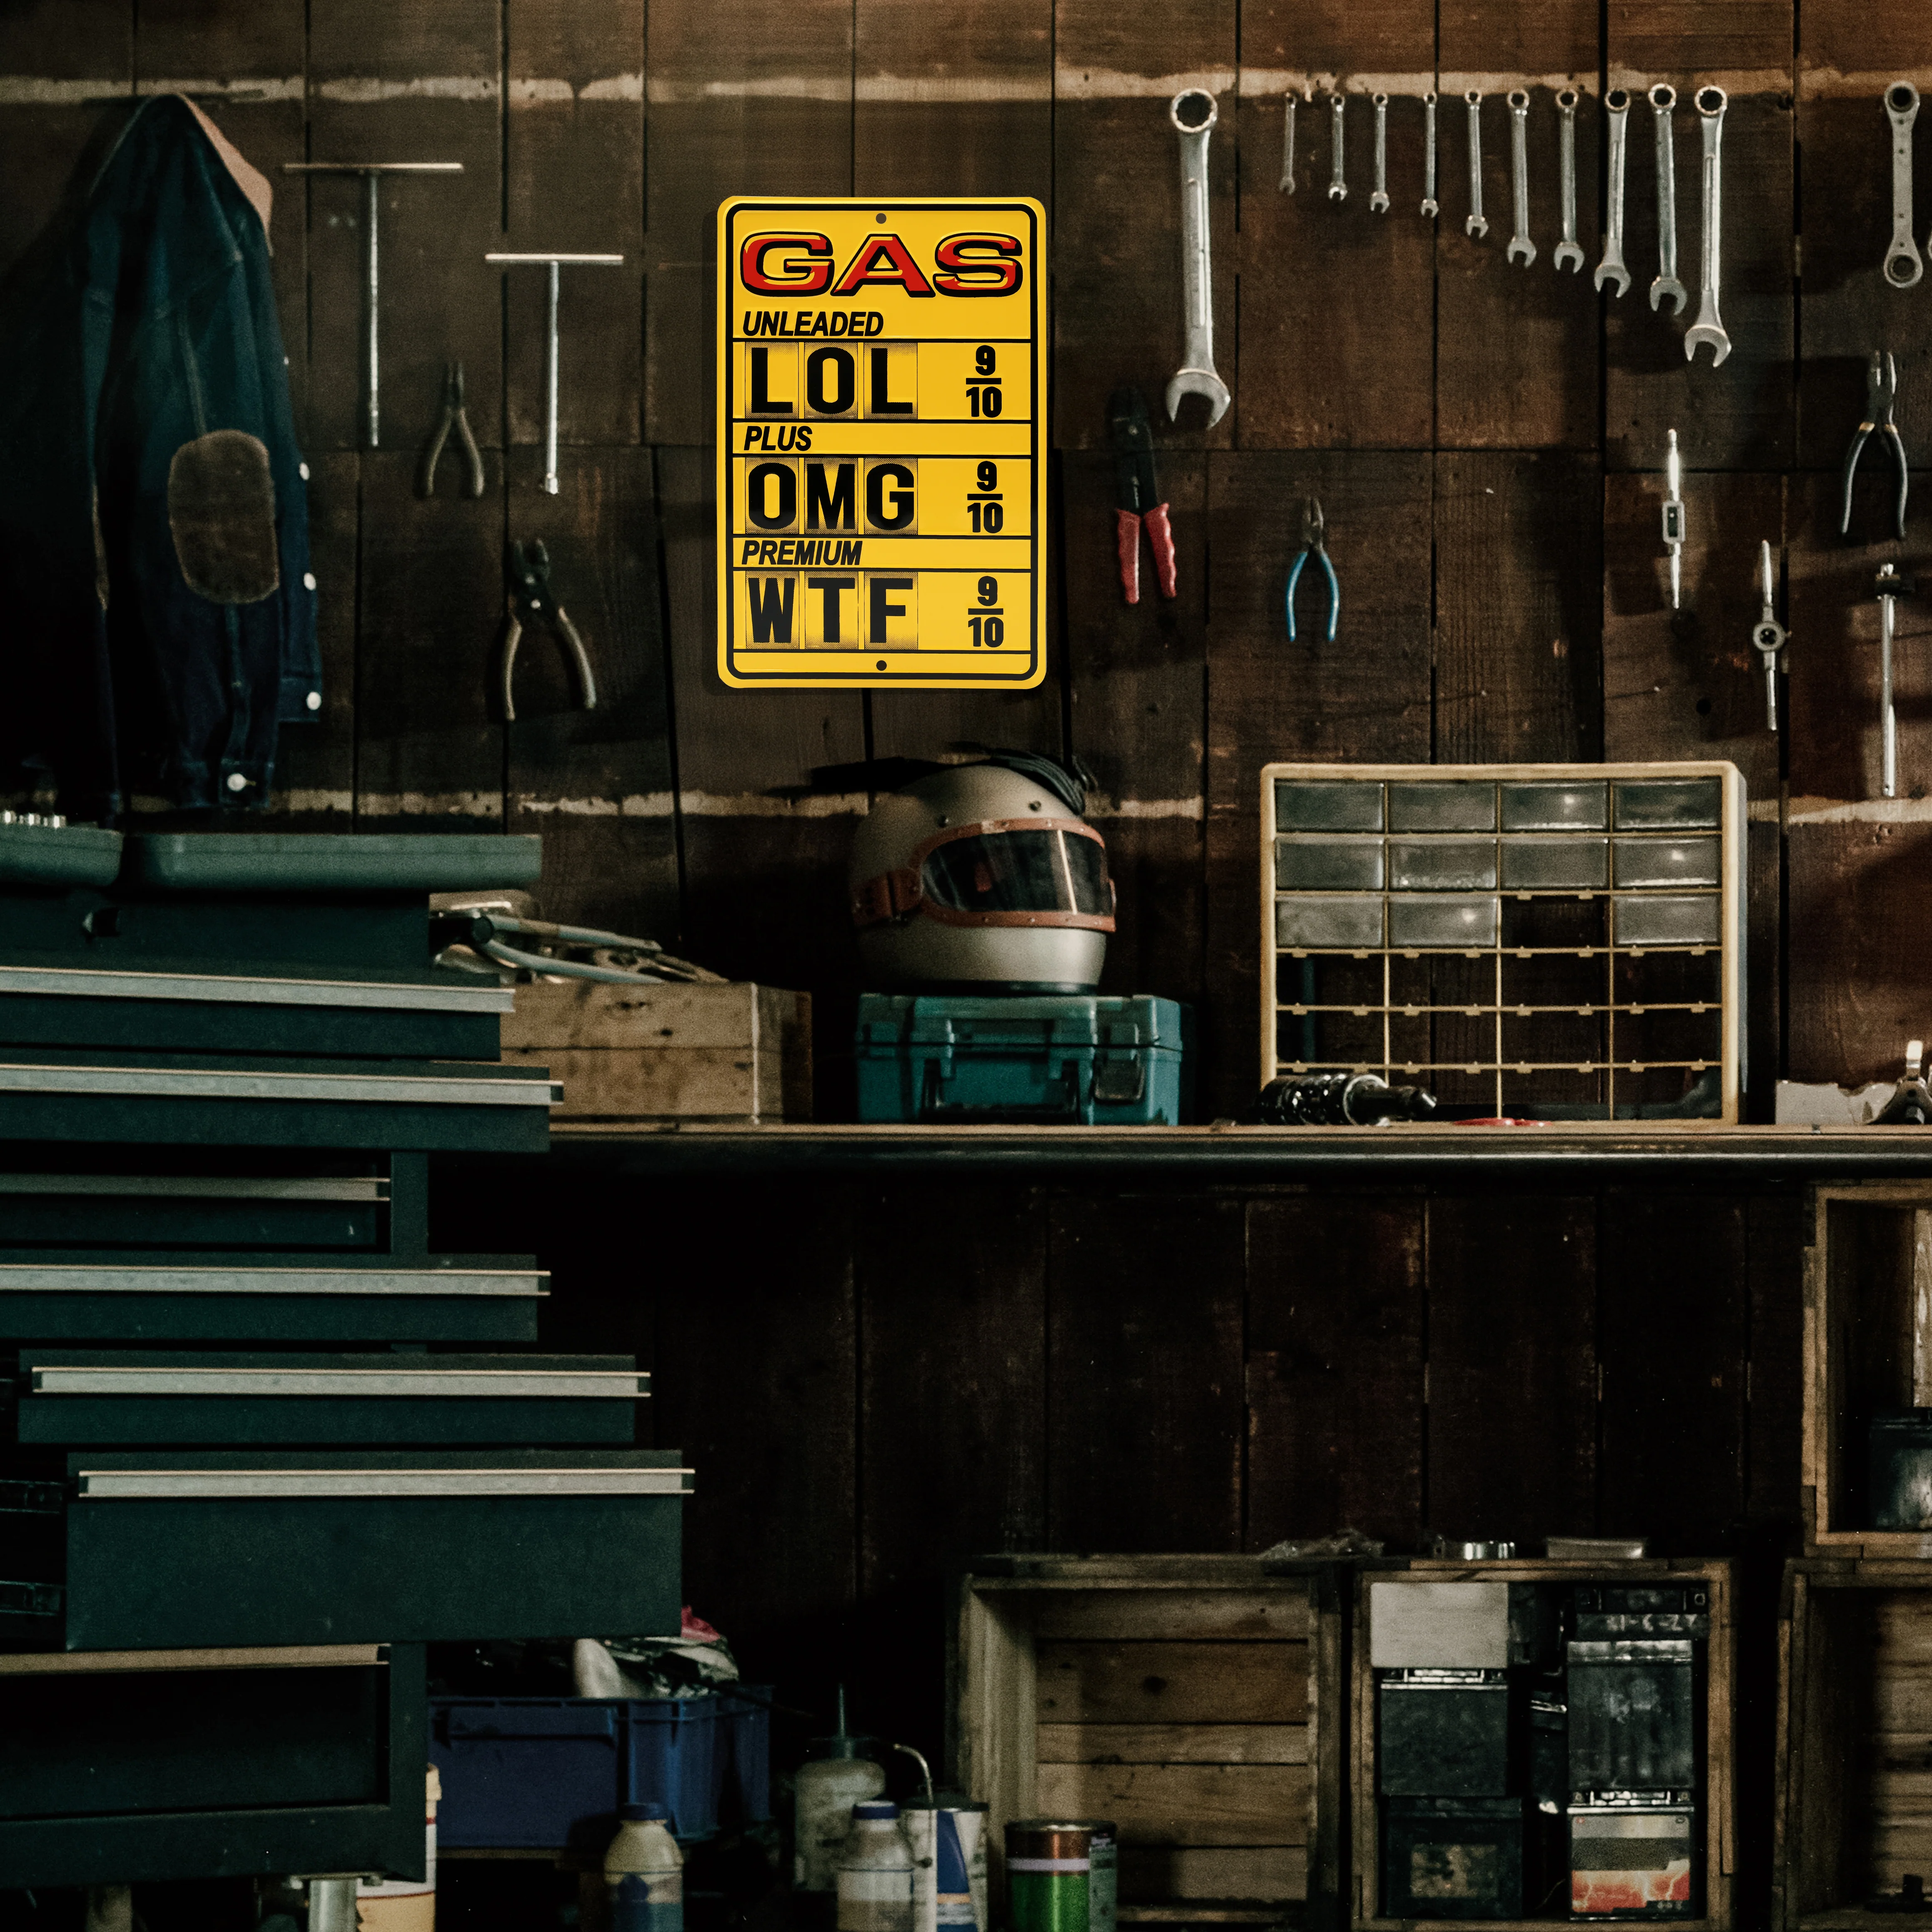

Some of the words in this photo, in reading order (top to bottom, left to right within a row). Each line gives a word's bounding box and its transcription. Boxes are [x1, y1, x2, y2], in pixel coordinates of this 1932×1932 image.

[741, 232, 1023, 298] GAS
[743, 311, 884, 336] UNLEADED
[976, 345, 996, 376] 9
[751, 347, 913, 414] LOL
[966, 386, 1002, 418] 10
[744, 426, 812, 451] PLUS
[977, 461, 997, 491] 9
[749, 463, 914, 530] OMG
[968, 502, 1003, 533] 10
[742, 540, 862, 566] PREMIUM
[978, 576, 997, 606] 9
[748, 578, 913, 644] WTF
[968, 617, 1004, 647] 10
